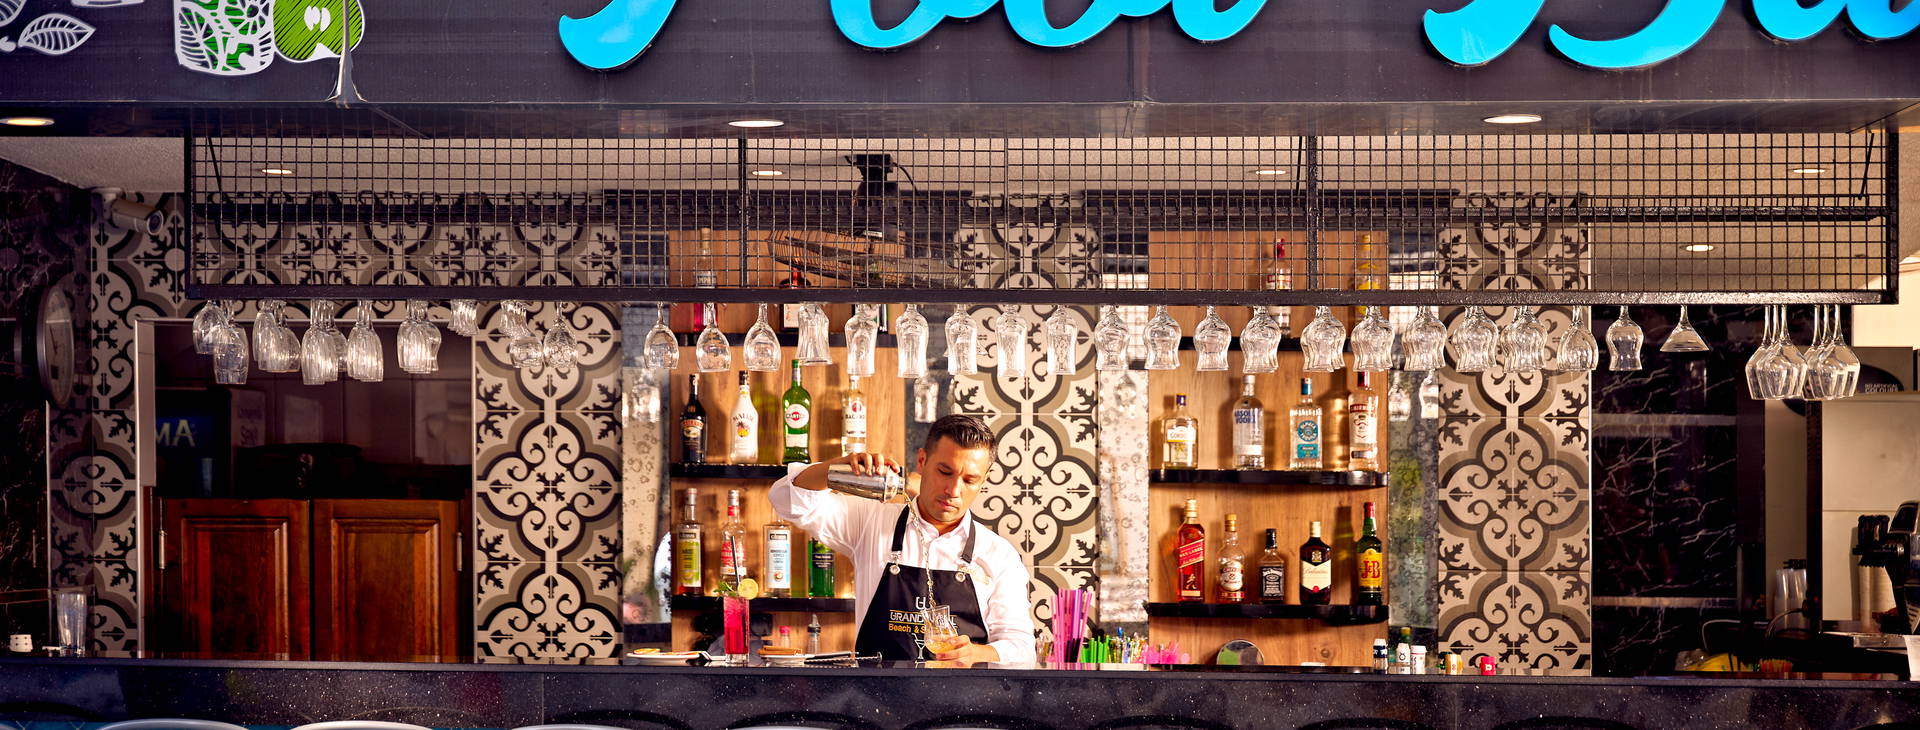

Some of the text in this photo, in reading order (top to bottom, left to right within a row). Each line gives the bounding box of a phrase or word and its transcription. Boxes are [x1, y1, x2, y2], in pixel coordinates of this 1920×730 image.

[890, 611, 924, 623] GRAND
[888, 623, 912, 632] Beach
[914, 625, 919, 633] &
